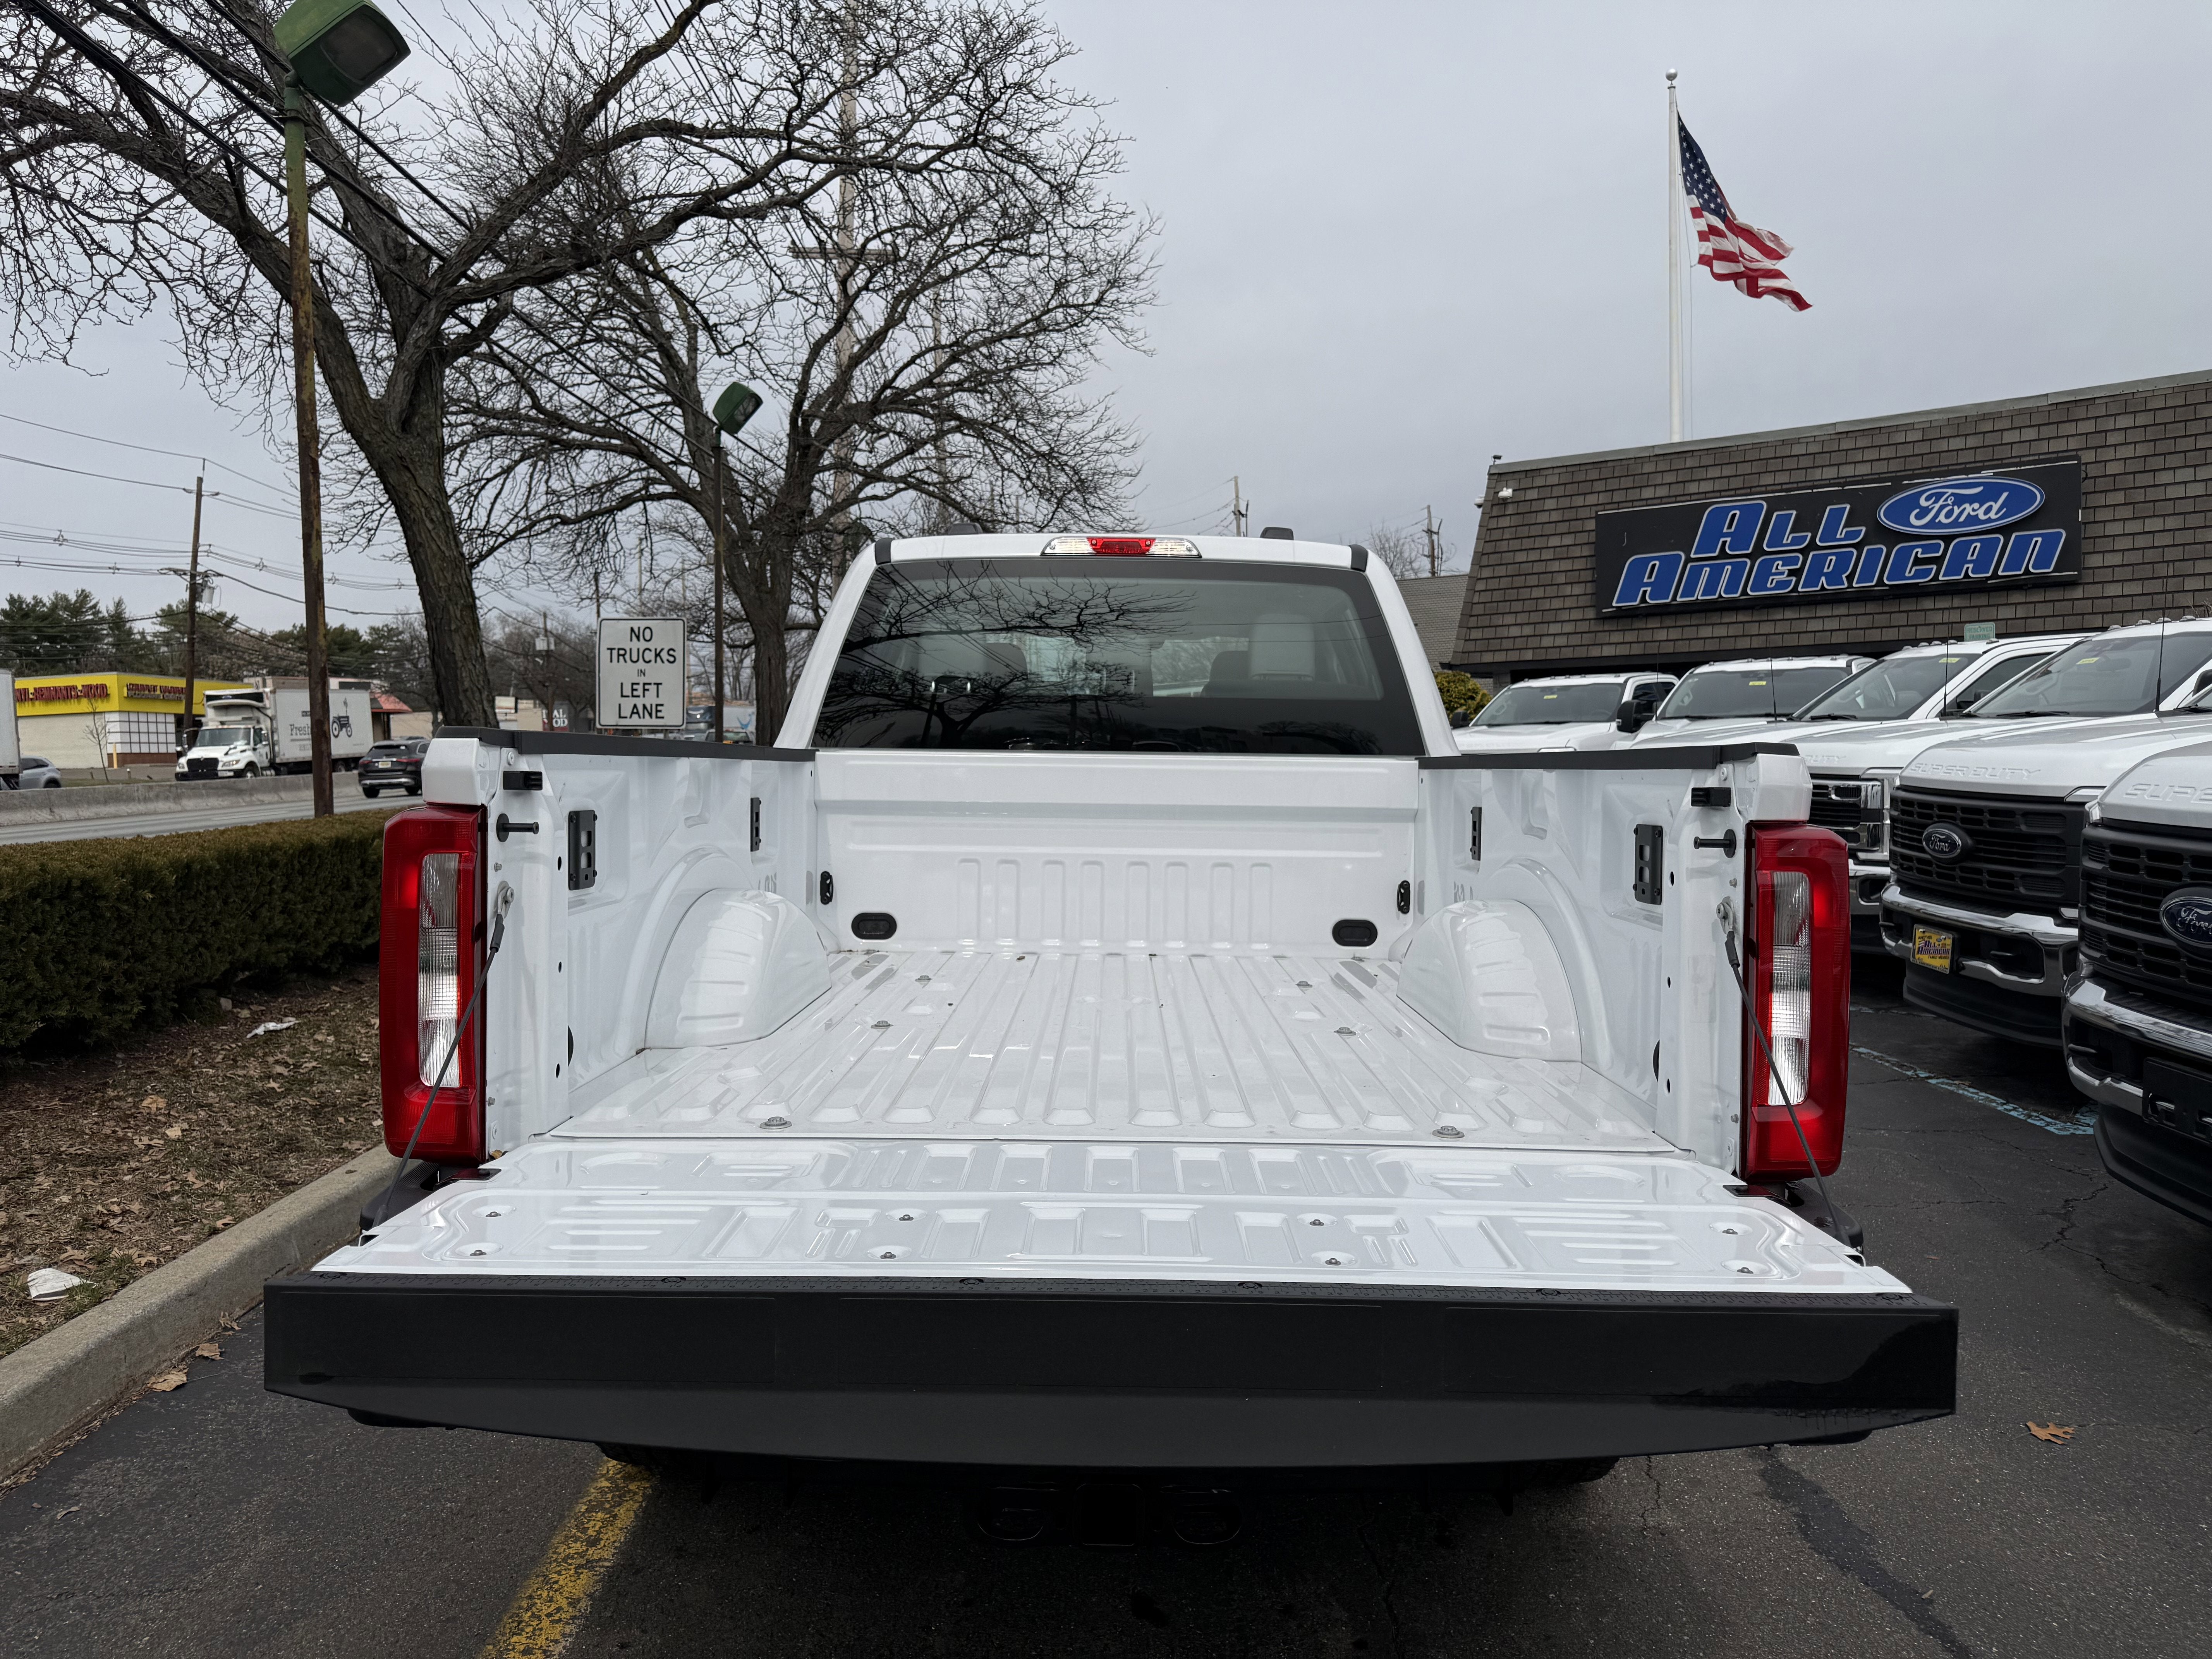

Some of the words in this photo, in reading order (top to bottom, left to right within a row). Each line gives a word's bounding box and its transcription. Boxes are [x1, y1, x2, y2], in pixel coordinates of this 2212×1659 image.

[1908, 486, 2009, 527] Ford
[1612, 528, 2066, 607] AMERICAN
[630, 626, 653, 642] NO
[606, 647, 677, 664] TRUCKS
[637, 668, 646, 677] IN
[620, 682, 663, 698] LEFT
[618, 703, 665, 719] LANE
[1909, 763, 1969, 776] SUPER
[1969, 766, 2041, 780] DUTY
